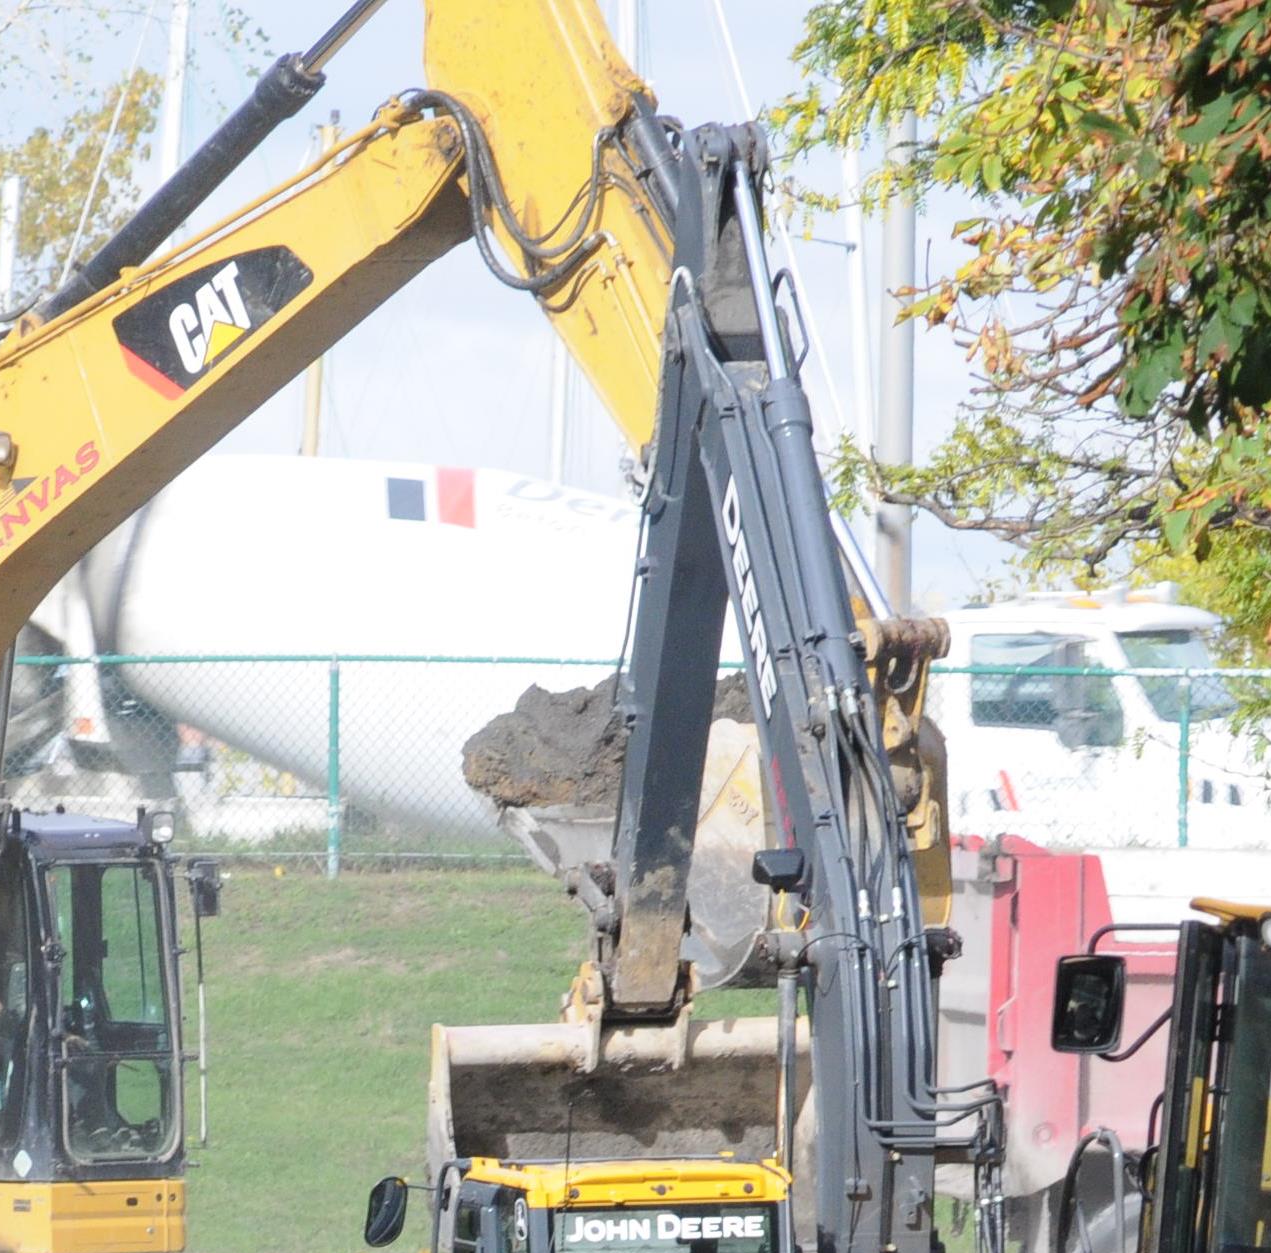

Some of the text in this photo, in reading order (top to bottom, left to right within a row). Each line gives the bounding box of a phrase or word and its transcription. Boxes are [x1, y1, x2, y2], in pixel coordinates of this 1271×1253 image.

[169, 260, 251, 375] CAT
[722, 473, 778, 721] DEERE
[566, 1213, 765, 1243] JOHN DEERE
